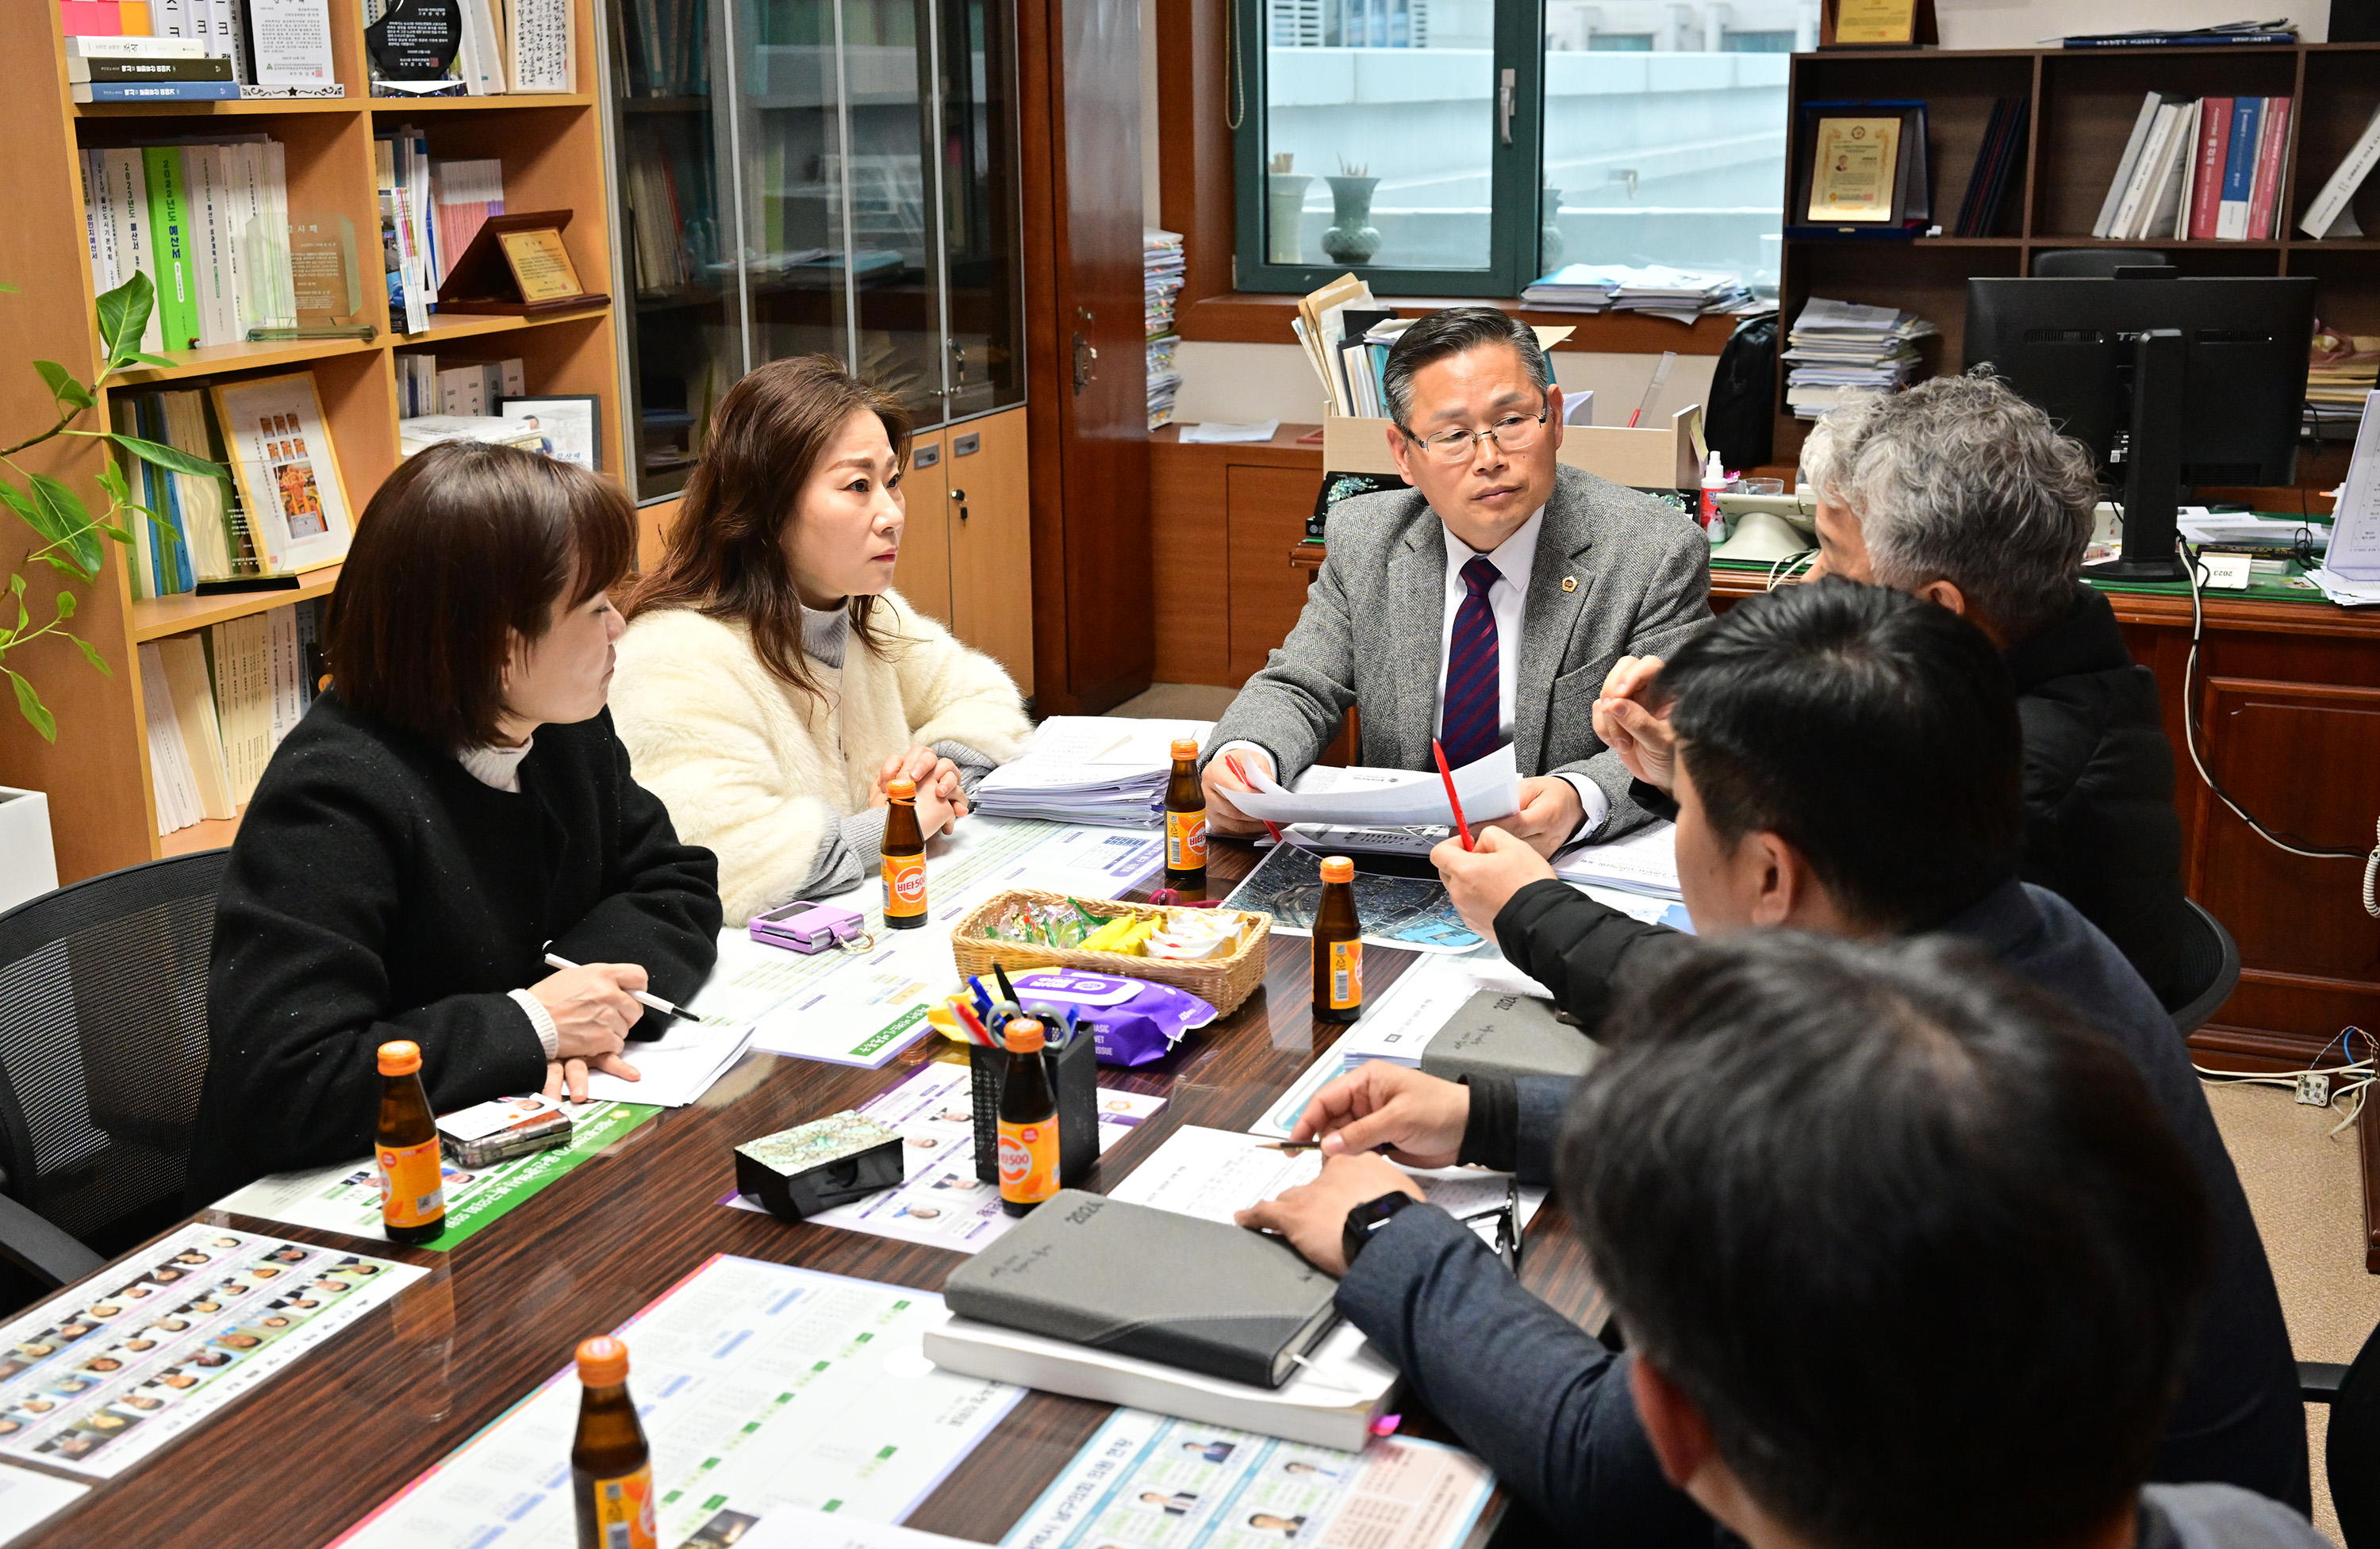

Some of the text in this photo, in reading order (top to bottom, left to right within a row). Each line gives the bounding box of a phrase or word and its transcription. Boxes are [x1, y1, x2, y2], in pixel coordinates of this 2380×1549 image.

[124, 163, 136, 218] 2023년도
[130, 222, 140, 251] 예산서
[163, 159, 177, 222] 2022년도
[86, 213, 98, 259] 성인지예산서
[101, 196, 113, 261] 울산도시기본계획
[169, 225, 181, 259] 예산서
[507, 1151, 561, 1189] 울산광역시
